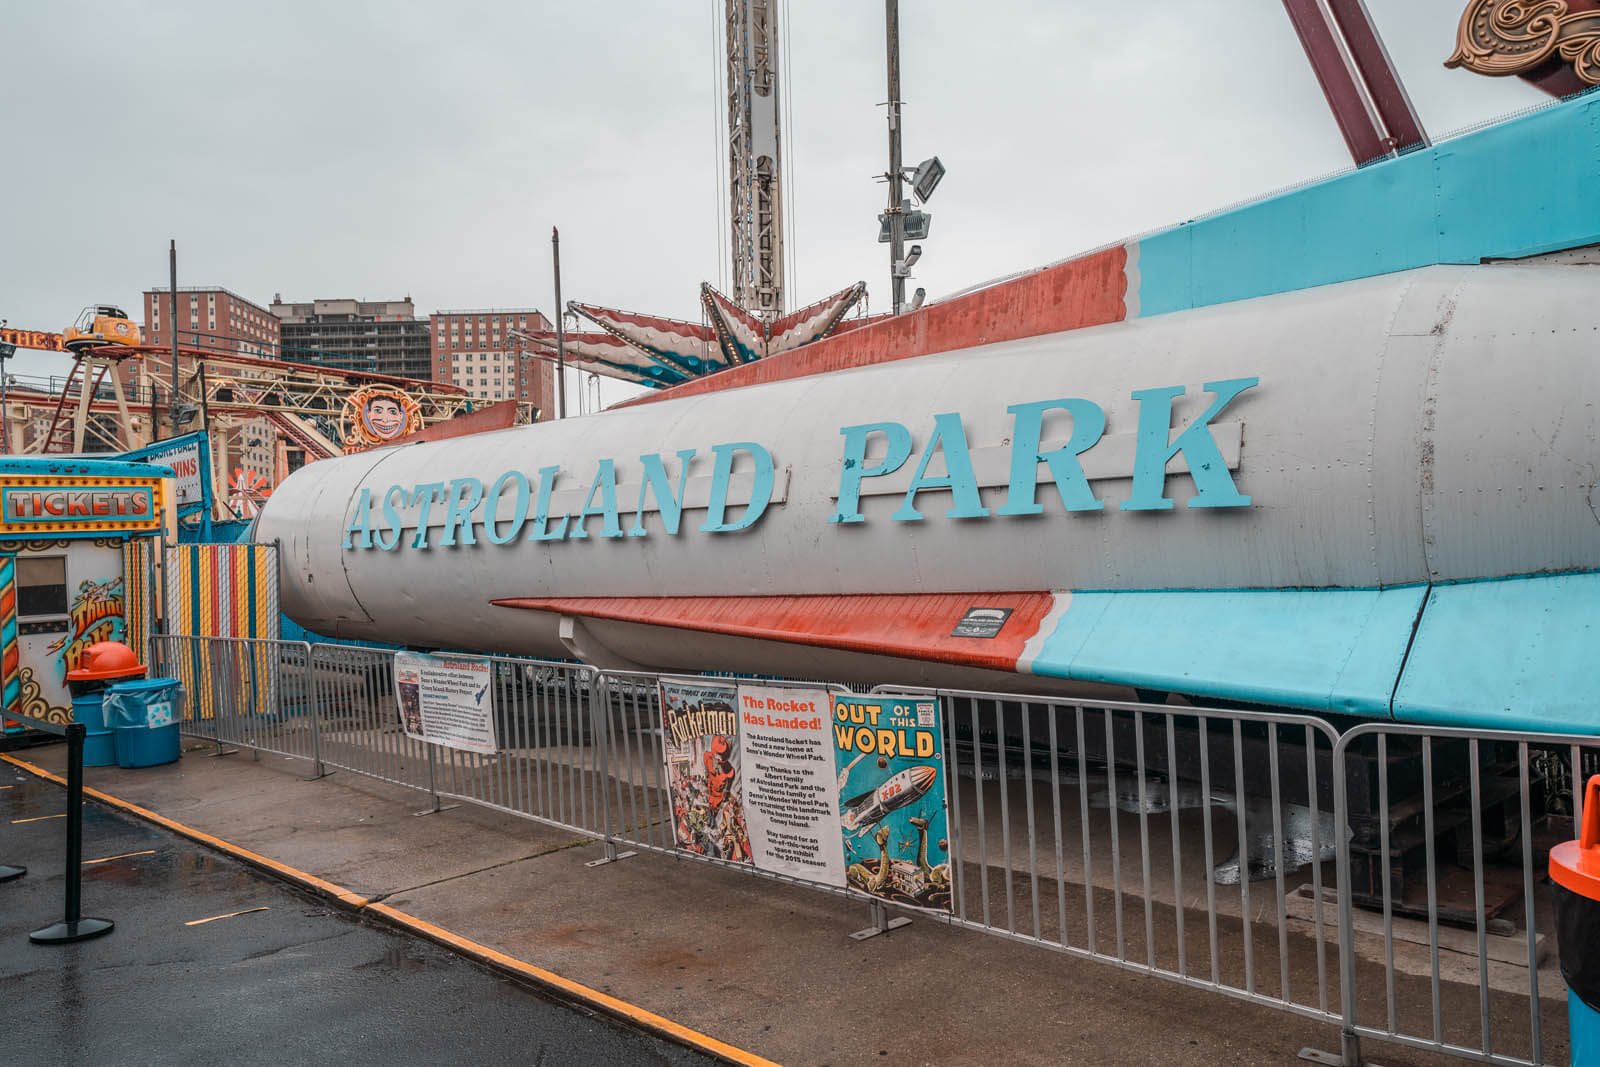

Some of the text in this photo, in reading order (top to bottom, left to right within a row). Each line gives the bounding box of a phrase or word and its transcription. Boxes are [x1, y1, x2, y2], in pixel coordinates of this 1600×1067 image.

[342, 377, 1259, 550] ASTROLAND PARK
[9, 491, 148, 517] TICKETS
[743, 696, 816, 713] The Rocket
[836, 703, 881, 726] OUT
[893, 705, 910, 716] OF
[744, 712, 822, 731] Has Landed!
[889, 717, 916, 727] THIS
[752, 741, 768, 749] found
[757, 734, 784, 744] Astroland
[785, 737, 808, 745] Rocket
[834, 724, 935, 758] WORLD
[763, 750, 785, 759] Wonder
[786, 753, 808, 761] Wheel
[755, 763, 770, 772] Many
[770, 766, 792, 775] Thanks
[757, 778, 784, 788] Astroland
[783, 775, 804, 784] family
[786, 790, 807, 799] family
[767, 795, 791, 804] Wonder
[814, 800, 829, 808] Park
[757, 801, 786, 812] returning
[799, 807, 831, 816] landmark
[770, 816, 788, 826] Coney
[775, 811, 793, 819] home
[766, 830, 779, 839] Stay
[779, 833, 797, 841] tuned
[767, 838, 819, 852] out-of-this-world
[774, 847, 815, 859] space exhibit
